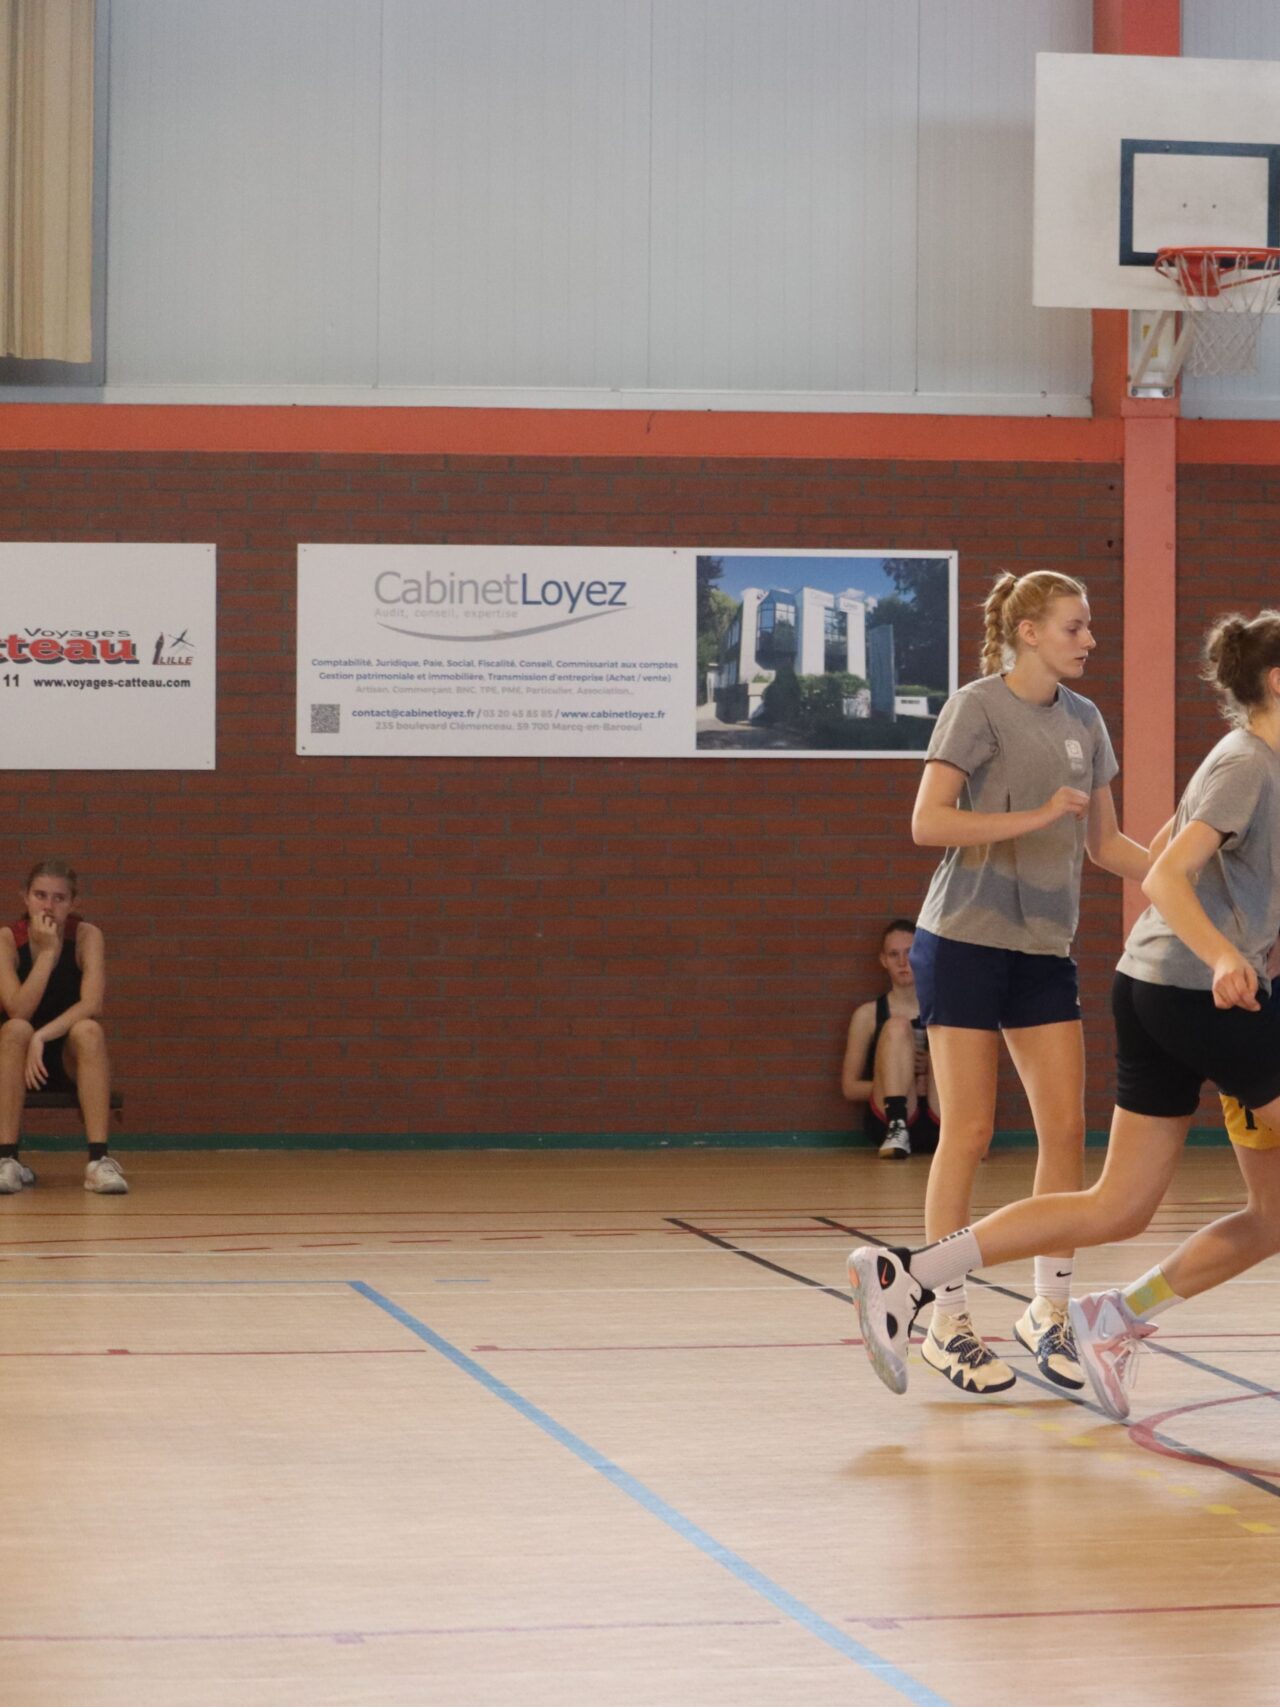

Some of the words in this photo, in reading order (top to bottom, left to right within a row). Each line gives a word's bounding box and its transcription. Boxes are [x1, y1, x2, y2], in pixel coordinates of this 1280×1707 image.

[464, 608, 519, 620] expertise
[24, 627, 131, 639] Voyages
[0, 633, 140, 664] teau
[160, 656, 193, 666] LILLE
[639, 661, 679, 670] comptes
[3, 673, 20, 687] 11
[34, 677, 191, 690] www.voyages-catteau.com
[319, 672, 354, 680] Gestion
[356, 672, 415, 681] patrimoniale
[417, 673, 426, 681] et
[488, 673, 547, 681] Transmission
[352, 708, 475, 719] contact@cabinetloyez.fr
[560, 709, 666, 720] www.cabinetloyez.fr
[396, 721, 447, 730] boulevard
